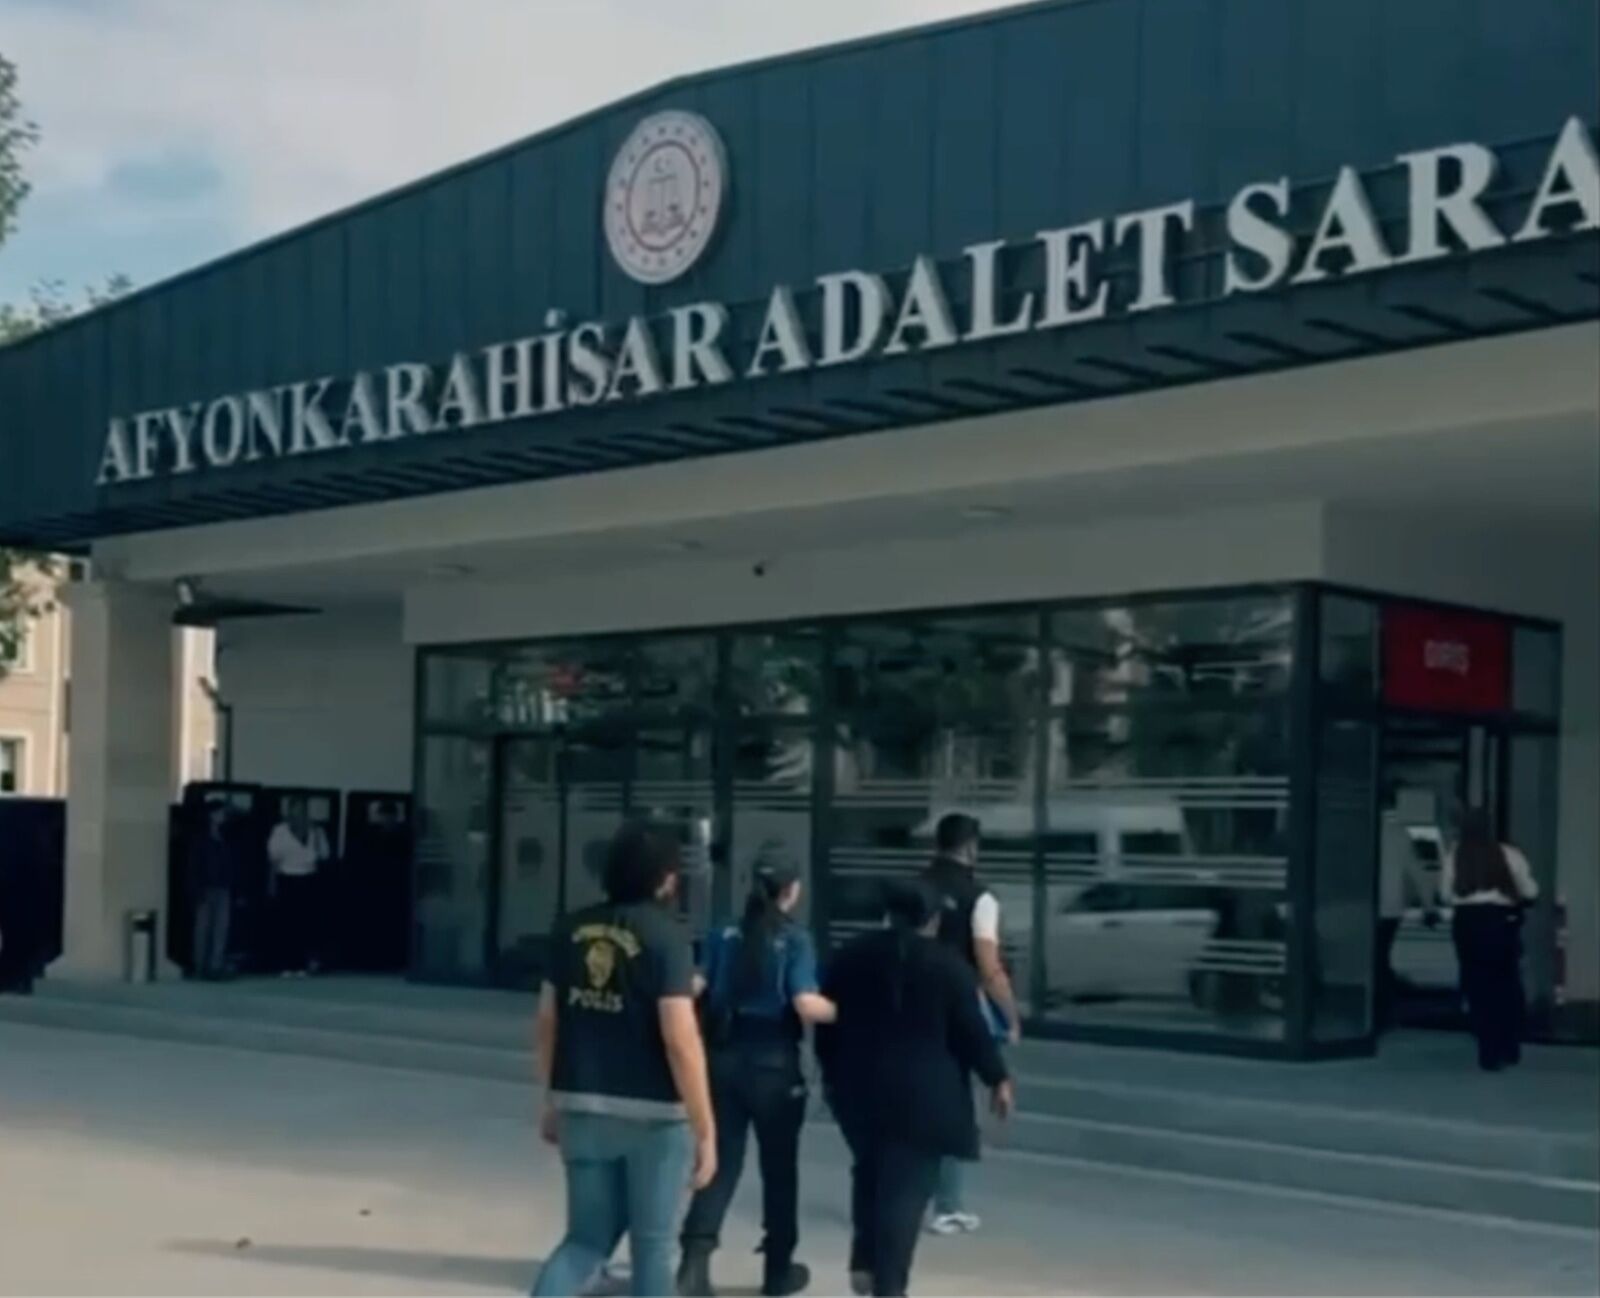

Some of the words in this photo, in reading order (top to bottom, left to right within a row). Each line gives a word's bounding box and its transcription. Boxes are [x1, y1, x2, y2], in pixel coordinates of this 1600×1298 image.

[96, 302, 733, 485] AFYONKARAHİSAR
[747, 200, 1194, 377] ADALET
[1224, 115, 1600, 295] SARA
